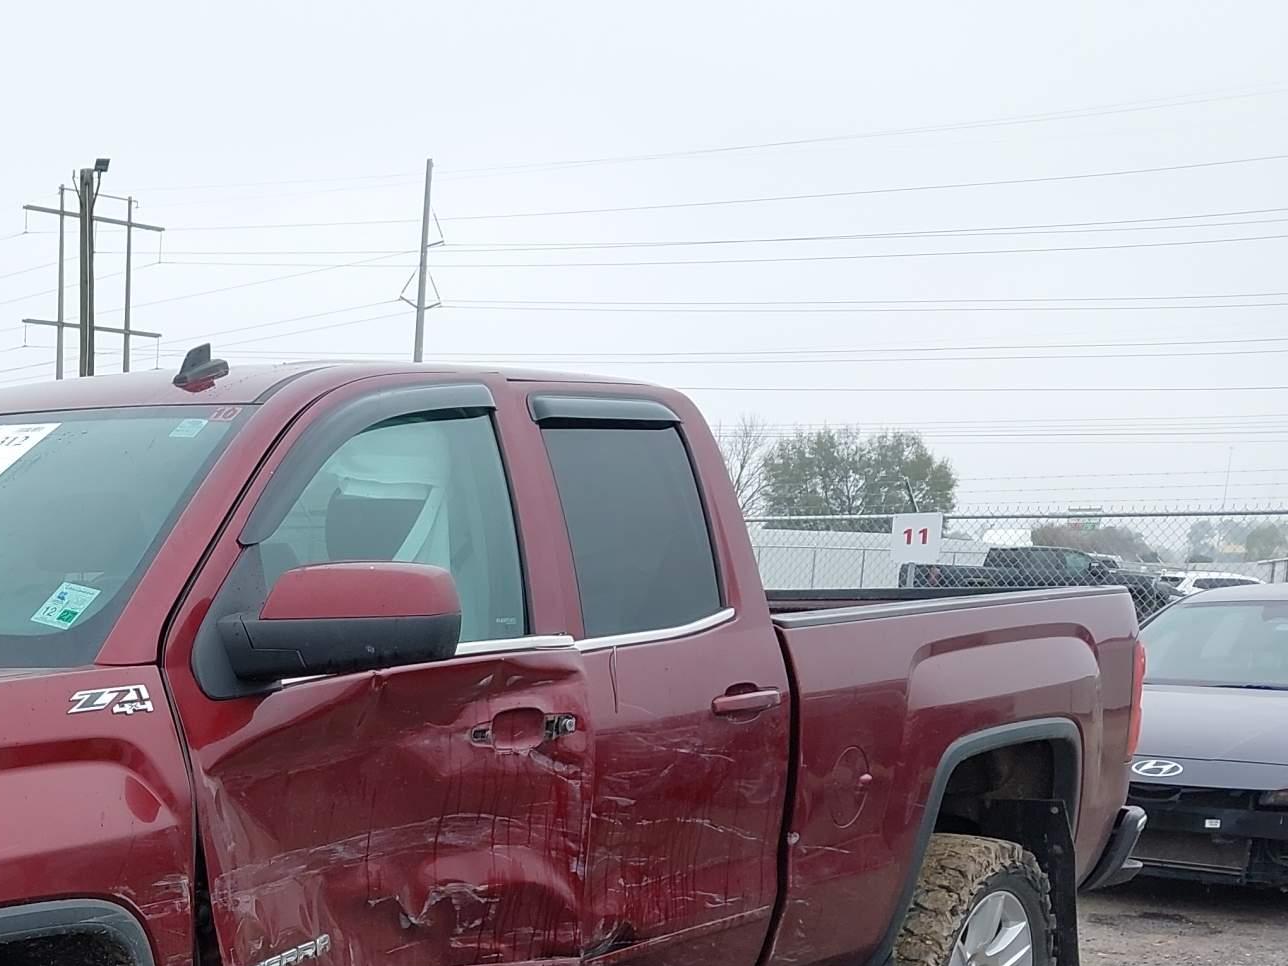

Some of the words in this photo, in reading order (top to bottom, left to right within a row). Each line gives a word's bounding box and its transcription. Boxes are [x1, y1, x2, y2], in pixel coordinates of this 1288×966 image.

[903, 527, 928, 545] 11
[42, 606, 58, 617] 12
[66, 684, 150, 714] Z71
